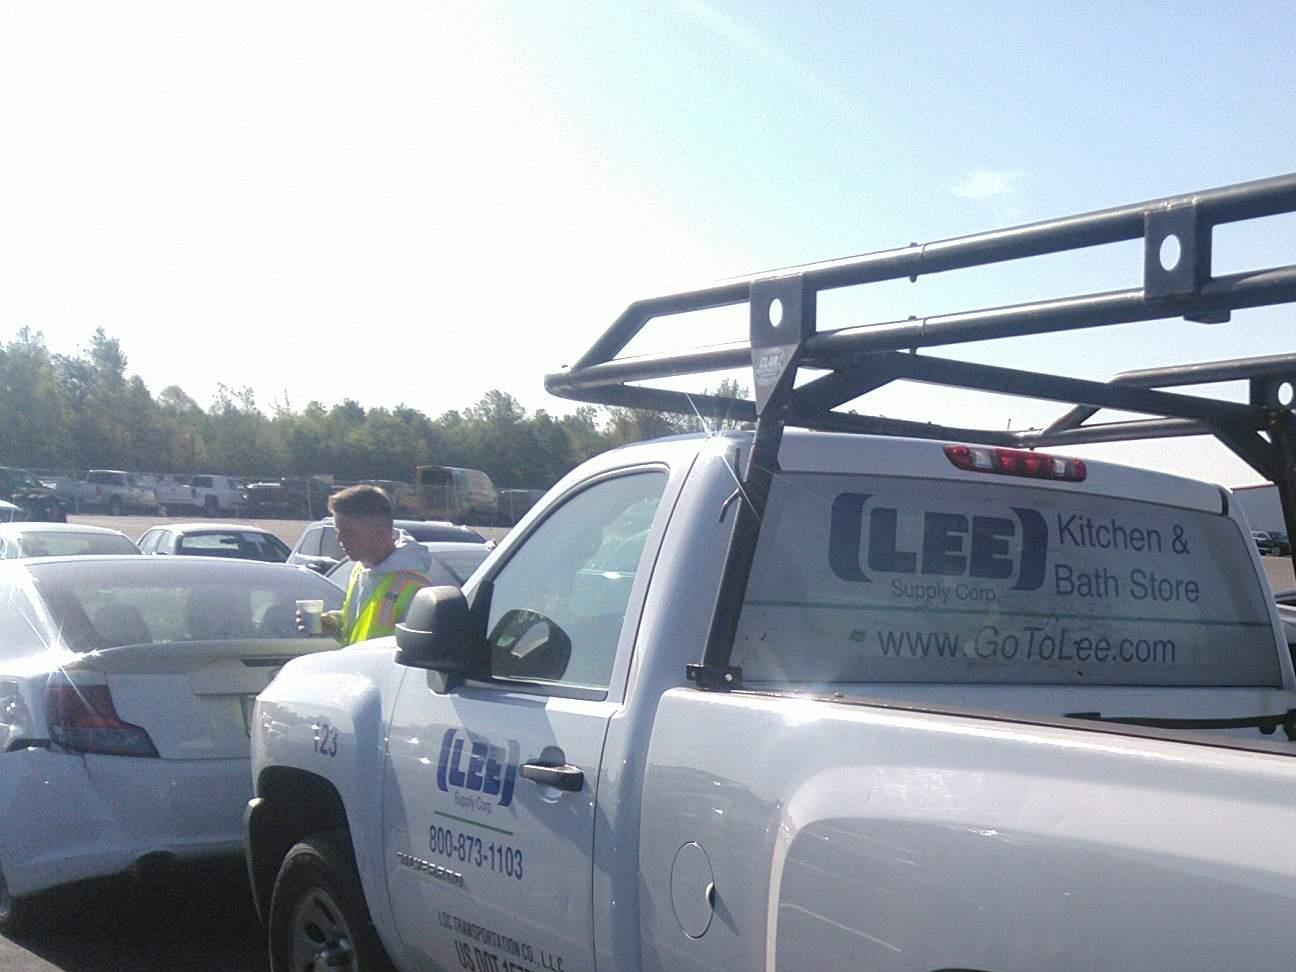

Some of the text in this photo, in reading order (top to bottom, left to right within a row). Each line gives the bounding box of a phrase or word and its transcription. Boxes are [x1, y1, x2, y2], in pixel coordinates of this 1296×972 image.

[1056, 513, 1191, 555] Kitchen &
[890, 578, 1000, 607] Supply Corp.
[1055, 563, 1200, 603] Bath Store
[878, 626, 1176, 664] www.GoToLee.com
[429, 825, 523, 880] 800-873-1103
[454, 939, 476, 972] US
